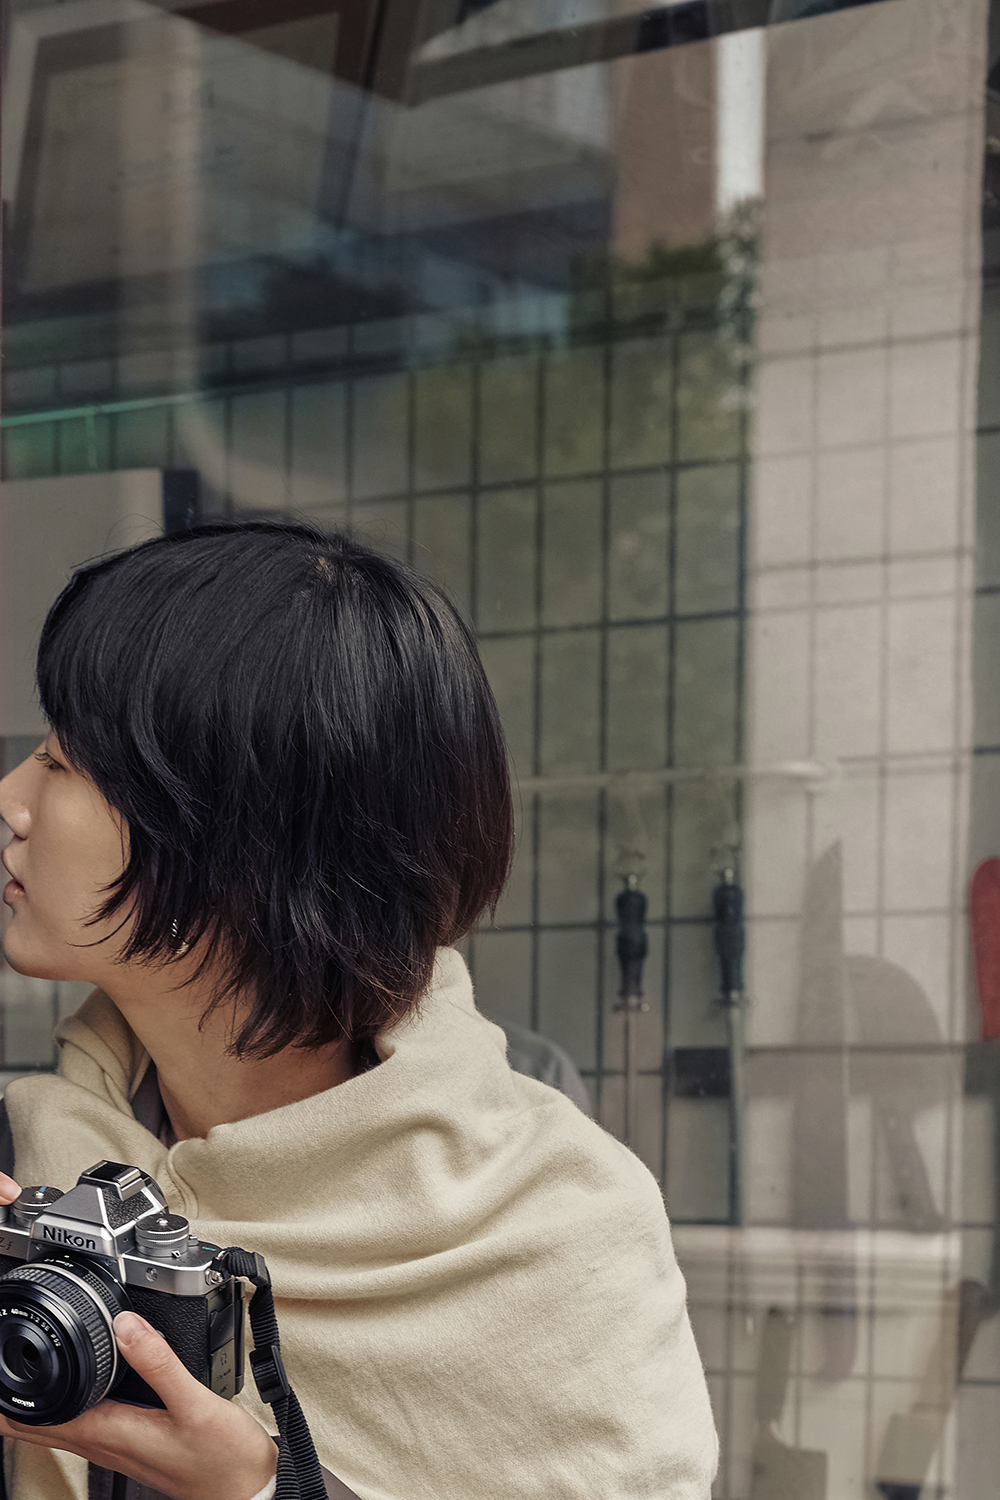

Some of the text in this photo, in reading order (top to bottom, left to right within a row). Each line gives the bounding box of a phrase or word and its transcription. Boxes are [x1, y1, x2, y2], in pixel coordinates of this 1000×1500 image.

[43, 1225, 96, 1250] Nikon
[1, 1308, 8, 1316] Z
[11, 1396, 36, 1408] Nikon
